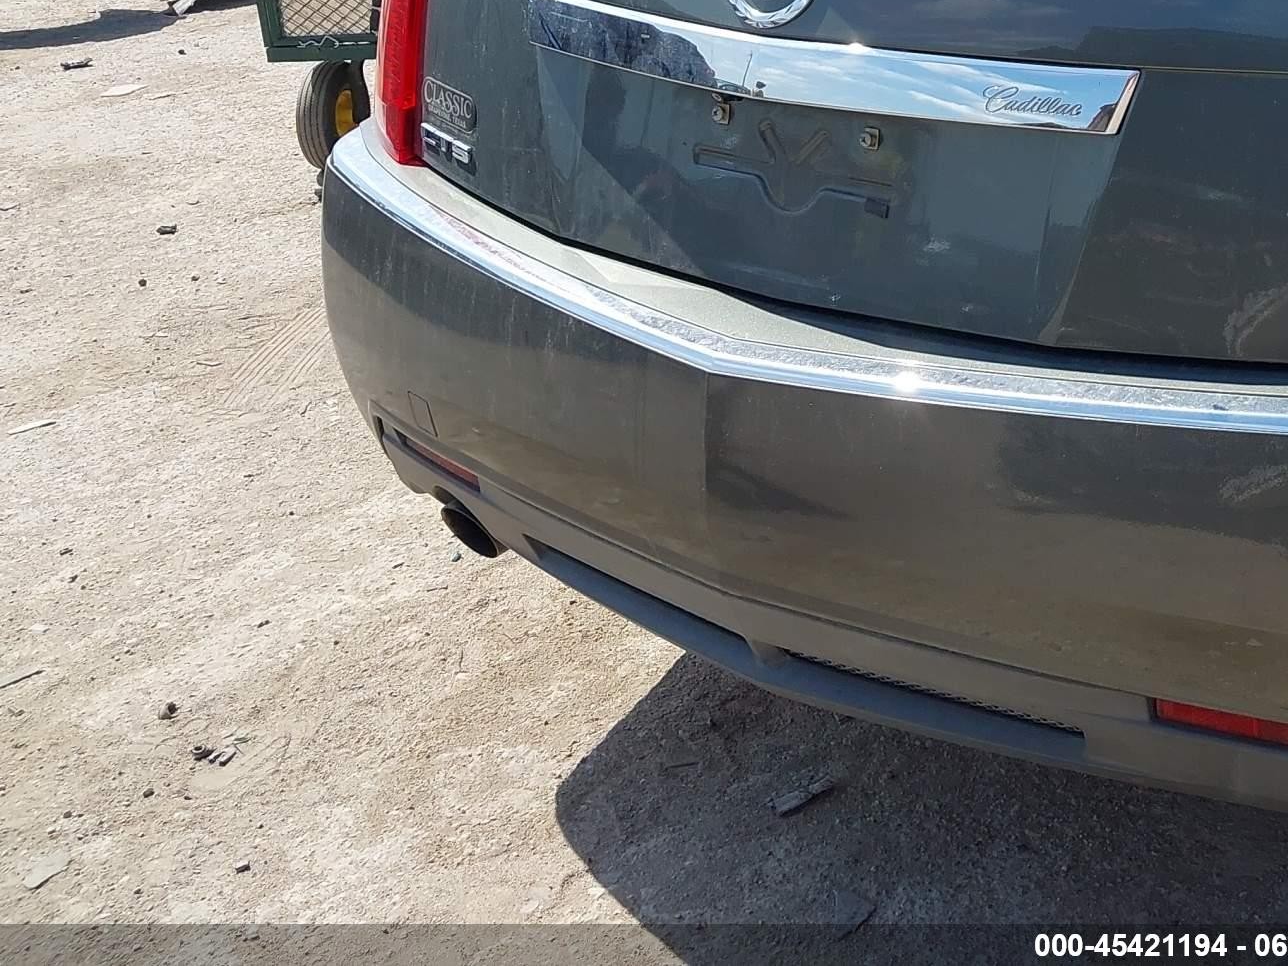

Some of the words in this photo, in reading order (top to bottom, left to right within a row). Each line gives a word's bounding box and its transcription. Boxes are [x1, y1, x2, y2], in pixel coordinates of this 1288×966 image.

[424, 80, 472, 119] CLASSIC
[983, 85, 1082, 115] Cadillac
[421, 122, 472, 164] CTS
